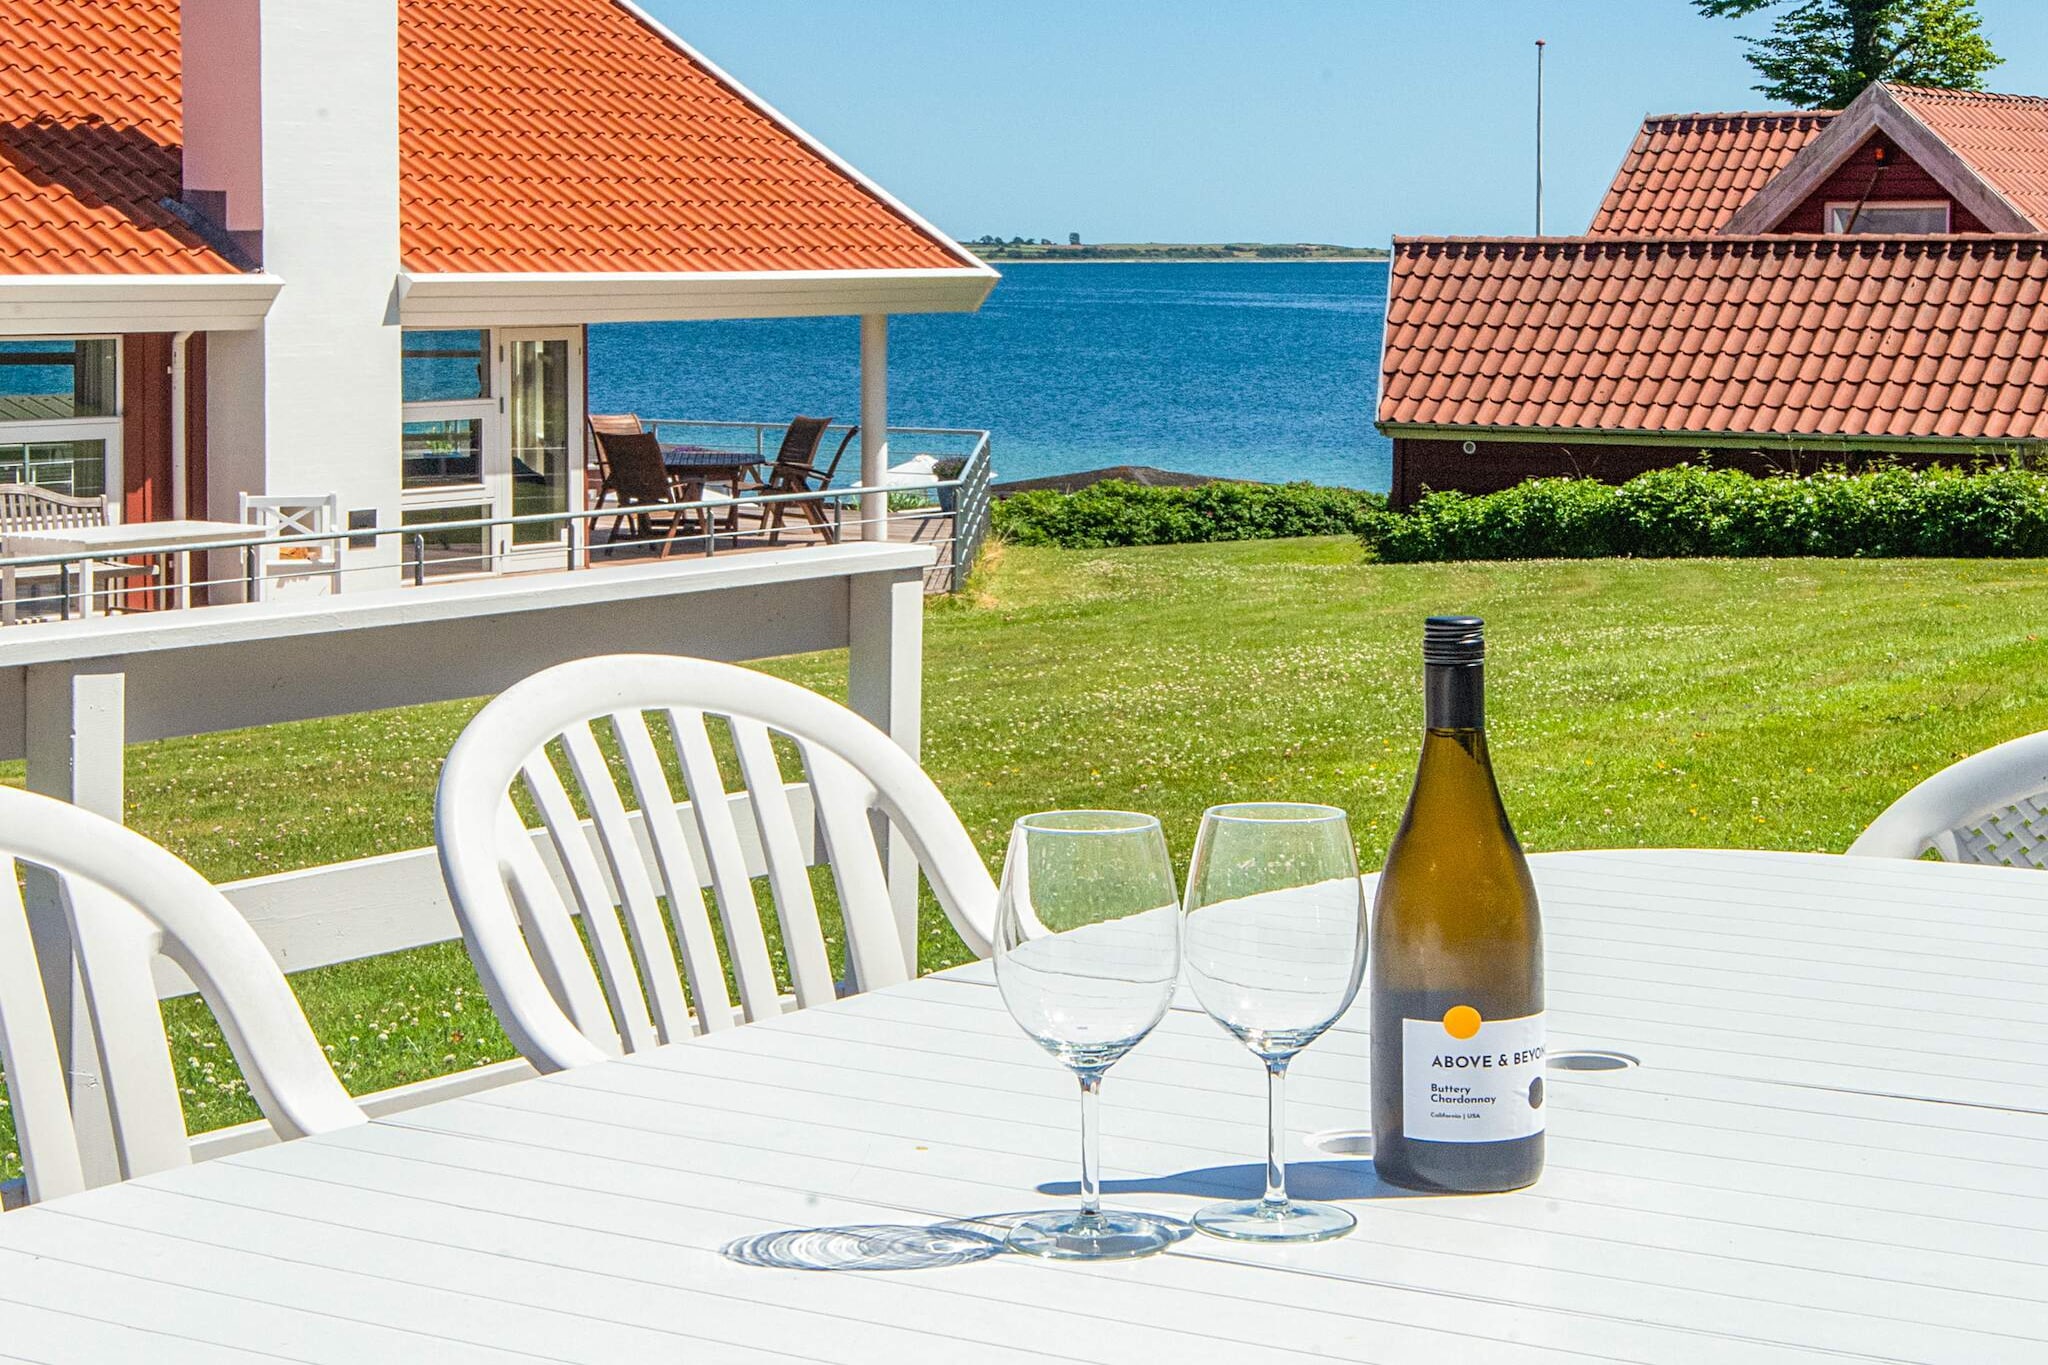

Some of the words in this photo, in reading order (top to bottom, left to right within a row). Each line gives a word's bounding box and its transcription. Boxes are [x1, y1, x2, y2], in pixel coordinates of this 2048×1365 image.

[1432, 1055, 1492, 1068] ABOVE
[1498, 1054, 1508, 1067] &
[1431, 1083, 1471, 1095] Buttery
[1430, 1094, 1497, 1104] Chardonnay
